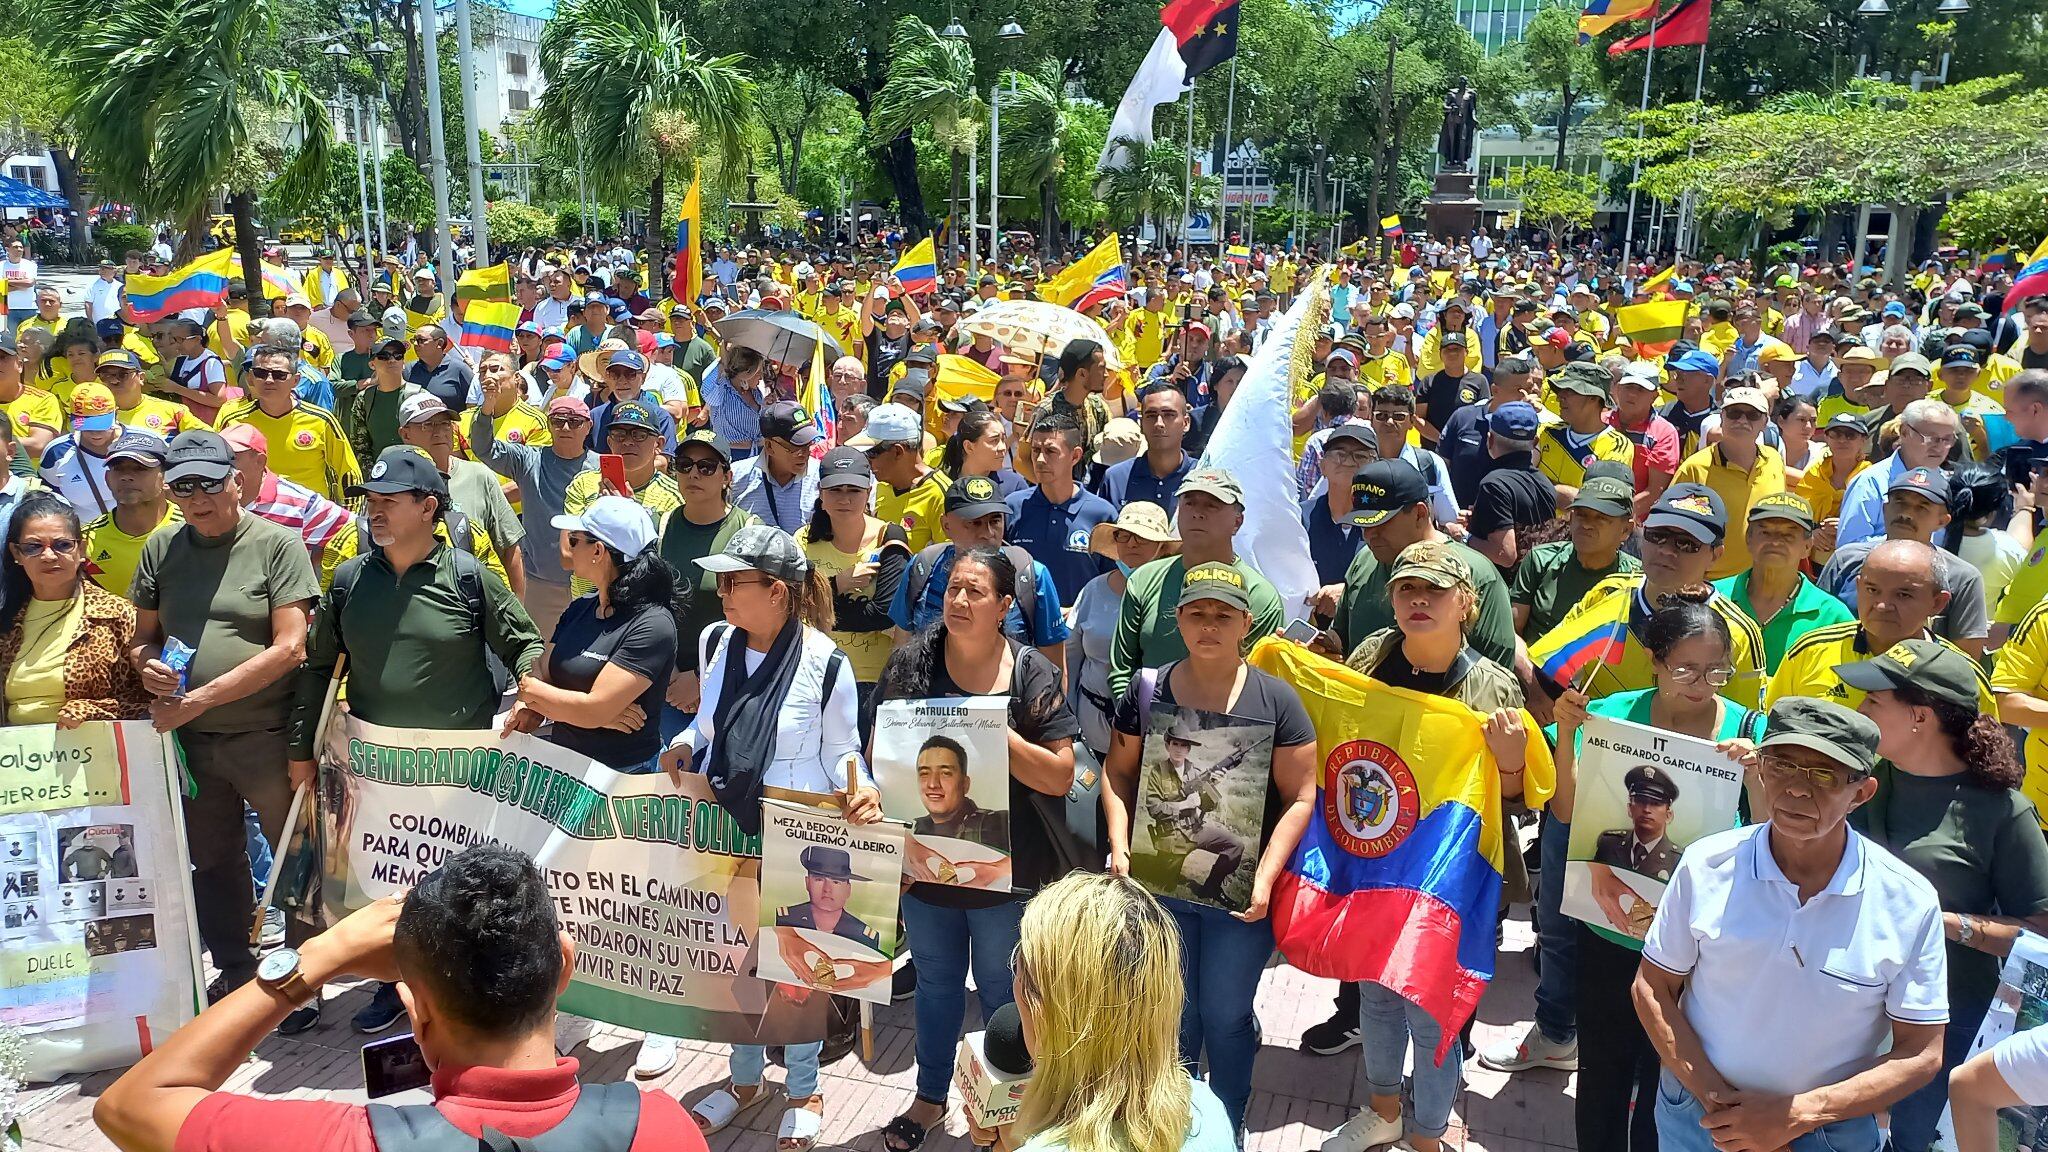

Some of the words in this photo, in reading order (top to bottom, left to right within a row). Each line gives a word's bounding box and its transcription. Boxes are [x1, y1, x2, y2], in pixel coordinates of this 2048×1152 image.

[1757, 495, 1809, 515] POLICIA
[1187, 568, 1242, 588] POLICIA
[915, 706, 968, 717] PATRULLERO
[0, 744, 93, 772] algunos
[1653, 737, 1668, 751] IT
[1329, 745, 1413, 796] REPUBLICA
[1587, 736, 1611, 750] ABEL
[1613, 743, 1661, 763] GERARDO
[1663, 756, 1702, 774] GARCIA
[1705, 766, 1738, 782] PEREZ
[349, 737, 529, 806] SEMBRADOR@S
[612, 794, 692, 849] VERDE
[773, 816, 803, 829] MEZA
[806, 821, 849, 837] BEDOYA
[1335, 824, 1408, 853] COLOMBIA
[362, 833, 410, 860] PARA
[785, 829, 847, 847] GUILLERMO
[849, 839, 898, 855] ALBEIRO.
[586, 871, 615, 892] EN
[621, 873, 641, 898] EL
[646, 878, 722, 915] CAMINO
[578, 896, 660, 932] INCLINES
[663, 914, 716, 944] ANTE
[722, 923, 750, 948] LA
[27, 952, 75, 973] DUELE
[657, 941, 680, 967] SU
[685, 947, 738, 975] VIDA
[573, 950, 615, 981] VIVIR
[619, 963, 643, 989] EN
[649, 968, 686, 997] PAZ
